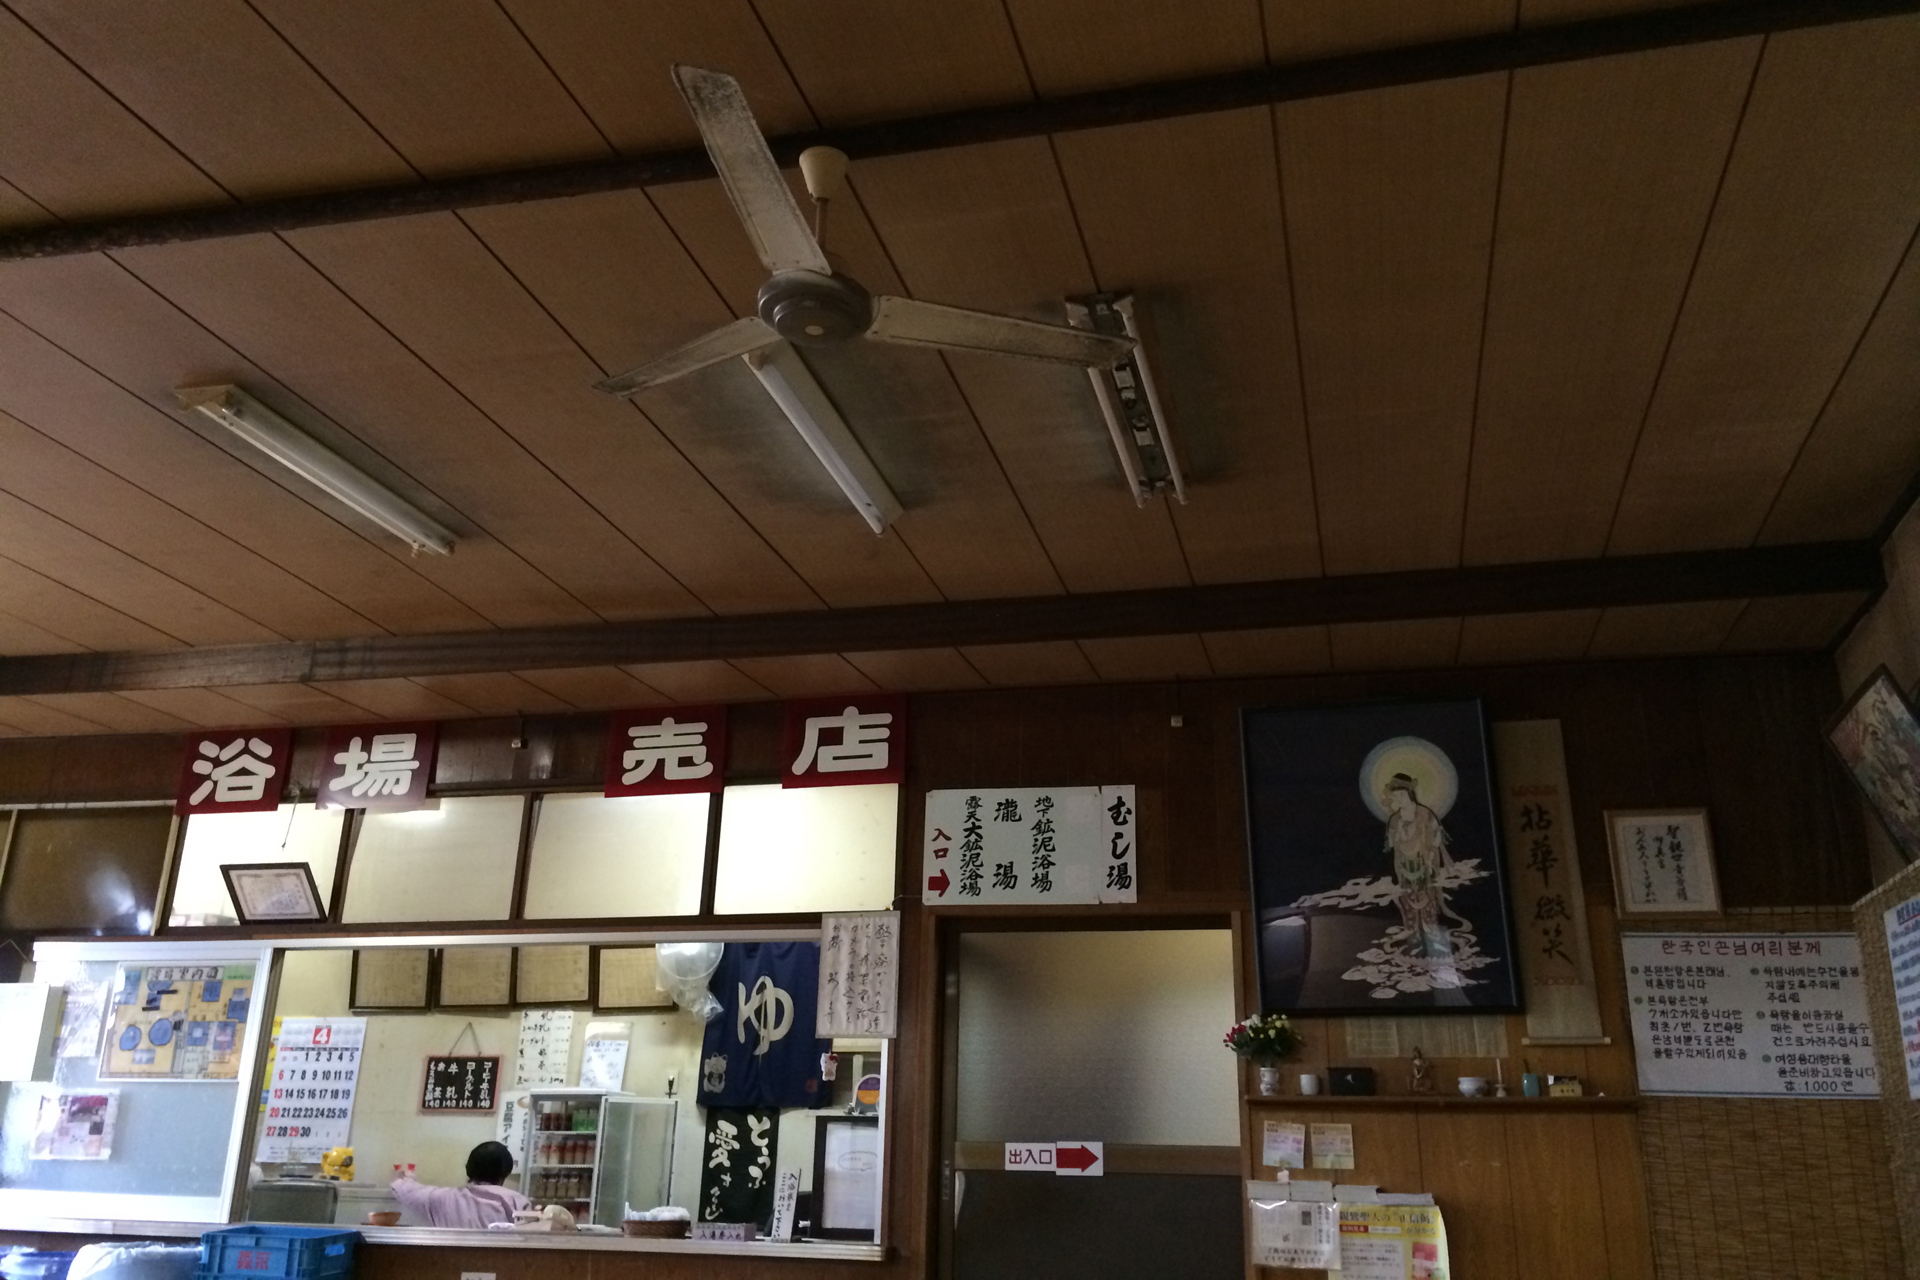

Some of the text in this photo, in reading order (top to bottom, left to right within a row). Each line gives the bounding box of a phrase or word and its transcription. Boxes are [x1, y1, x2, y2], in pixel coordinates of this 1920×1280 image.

[622, 705, 893, 785] 売店
[189, 733, 420, 806] 浴場
[931, 828, 953, 860] 入口
[959, 795, 984, 897] 露天大鉱泥浴場
[1030, 795, 1056, 893] 地下鉱泥浴場
[1106, 795, 1132, 891] むし湯
[737, 975, 795, 1056] ゆ
[314, 1028, 331, 1045] 4
[305, 1052, 309, 1062] 1
[315, 1052, 322, 1062] 2
[326, 1052, 333, 1062] 3
[338, 1052, 343, 1062] 4
[349, 1052, 355, 1062] 5
[278, 1070, 354, 1081] 6 7 8 9 10 11 12
[273, 1089, 351, 1099] 13 14 15 16 17 18 19
[425, 1099, 441, 1108] 140
[442, 1099, 457, 1108] 140
[459, 1099, 474, 1108] 140
[477, 1099, 491, 1108] 140
[269, 1107, 349, 1119] 20 21 22 23 24 25 26
[266, 1126, 277, 1137] 27
[277, 1126, 288, 1137] 28
[289, 1126, 300, 1137] 29
[300, 1126, 312, 1137] 30
[1008, 1148, 1052, 1165] 出入口
